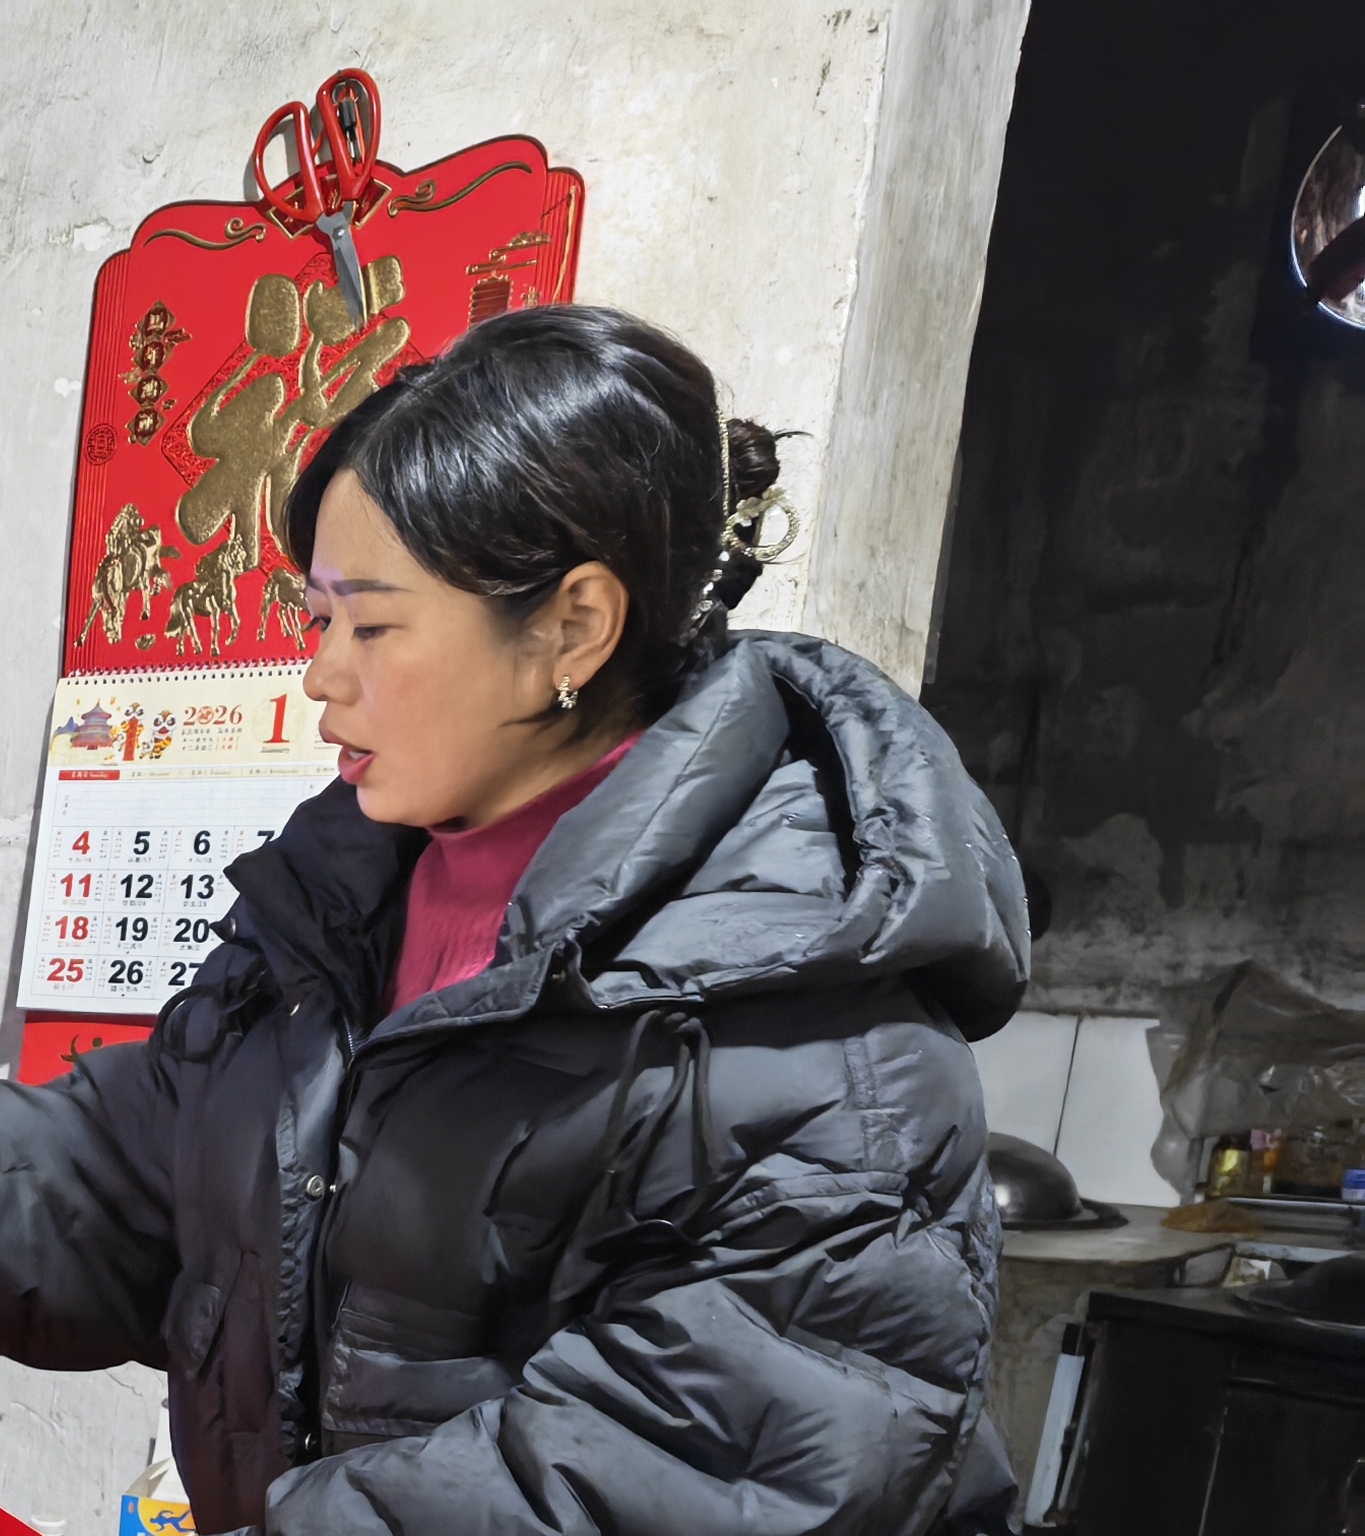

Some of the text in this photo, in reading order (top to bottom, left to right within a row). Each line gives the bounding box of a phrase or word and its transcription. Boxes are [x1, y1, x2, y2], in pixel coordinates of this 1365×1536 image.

[182, 704, 243, 726] 2026
[268, 693, 290, 744] 1
[72, 830, 90, 855] 4
[133, 830, 151, 855] 5
[193, 830, 211, 855] 6
[60, 873, 215, 900] 11 12 13
[55, 916, 210, 943] 18 19 20
[47, 958, 85, 983] 25
[108, 960, 144, 985] 26
